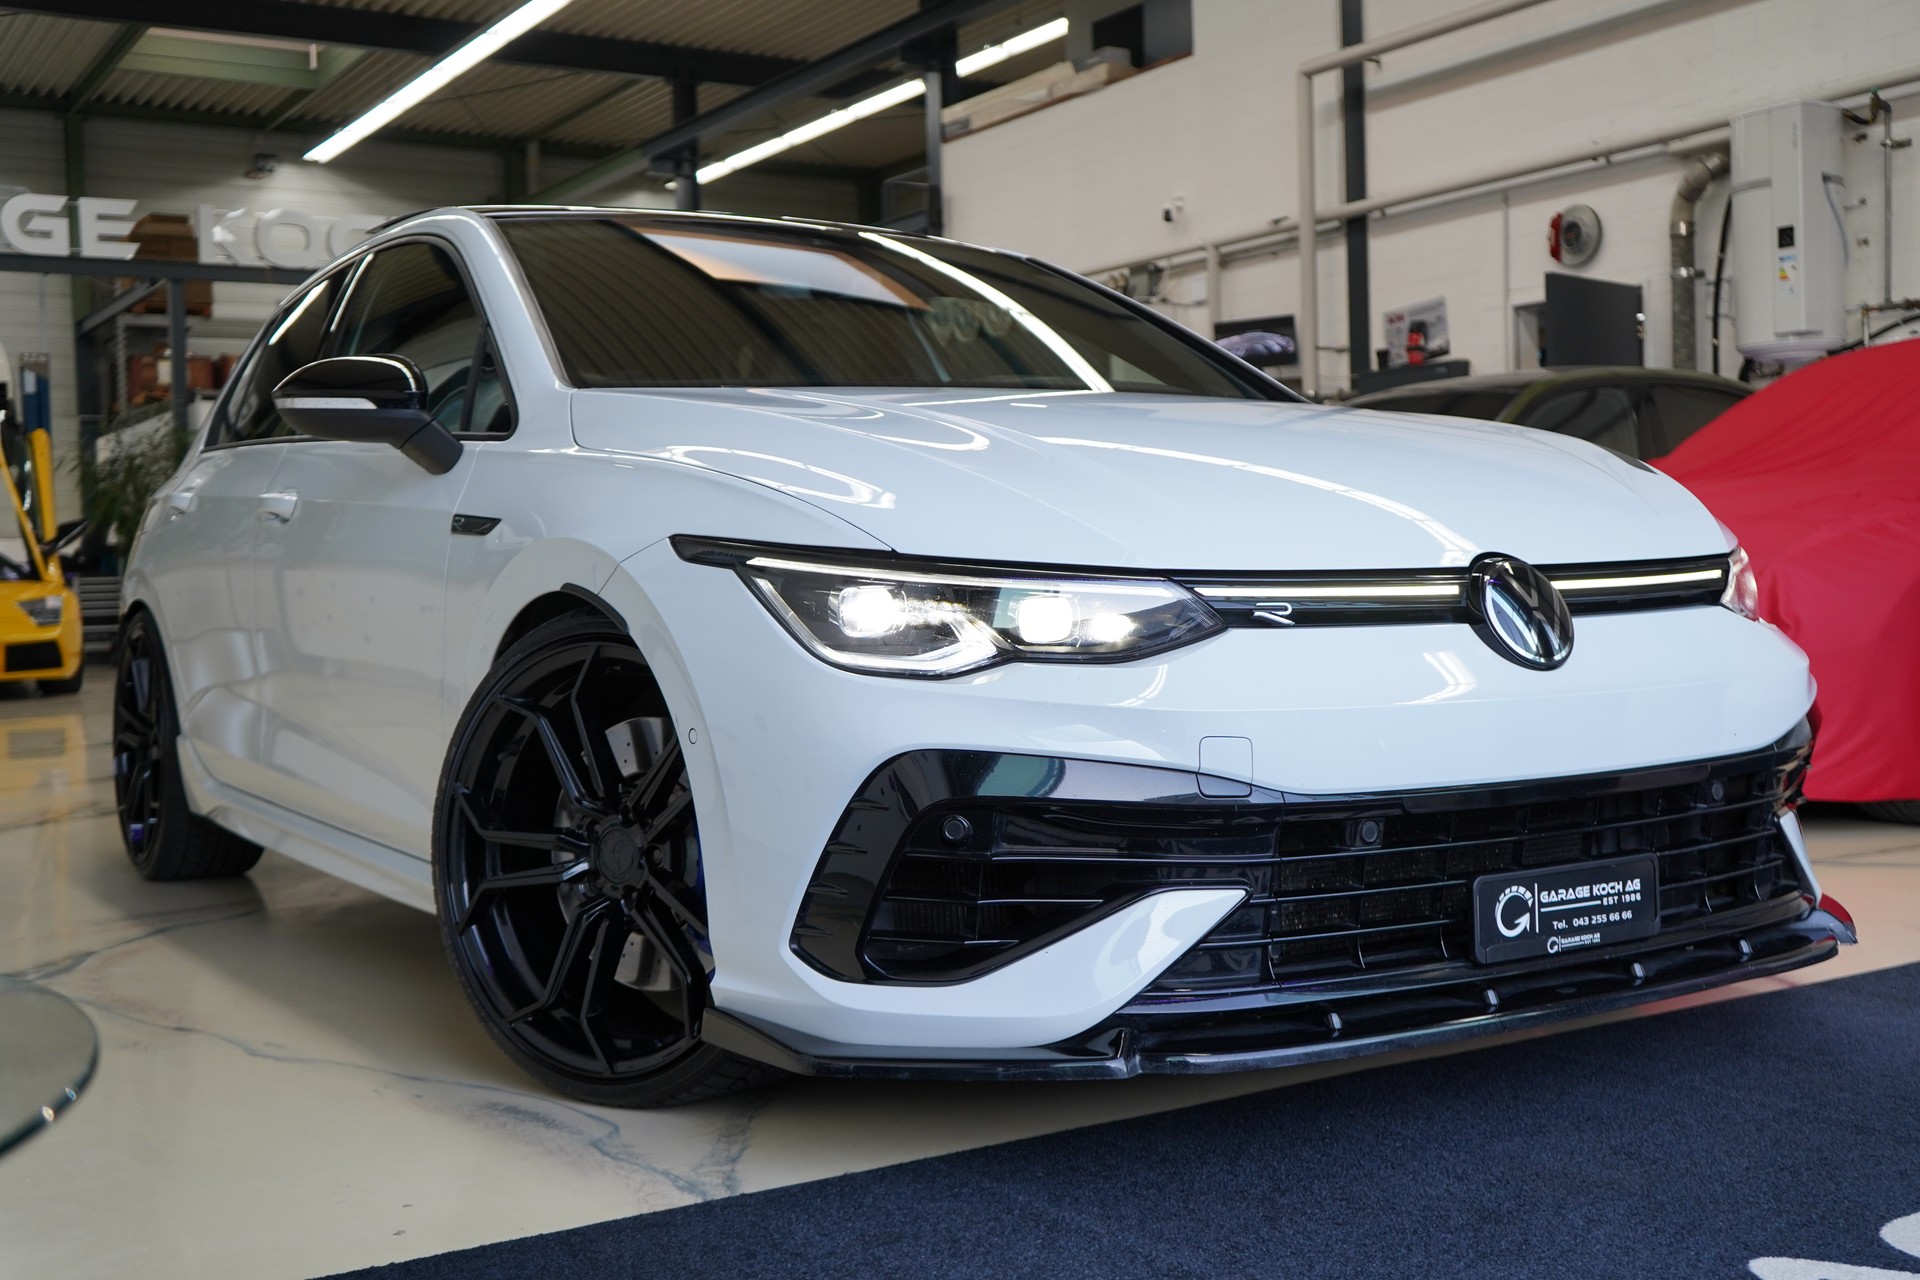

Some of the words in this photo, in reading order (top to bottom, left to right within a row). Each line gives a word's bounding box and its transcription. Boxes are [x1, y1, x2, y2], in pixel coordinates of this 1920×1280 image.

[1540, 885, 1590, 903] GARAGE
[1592, 881, 1623, 897] KOCH
[1625, 878, 1641, 892] AG
[1603, 896, 1618, 906] EST
[1621, 893, 1641, 903] 1986
[1552, 920, 1568, 930] Tel.
[1572, 916, 1589, 927] 043
[1591, 913, 1607, 924] 255
[1609, 912, 1620, 921] 66
[1621, 910, 1632, 920] 66
